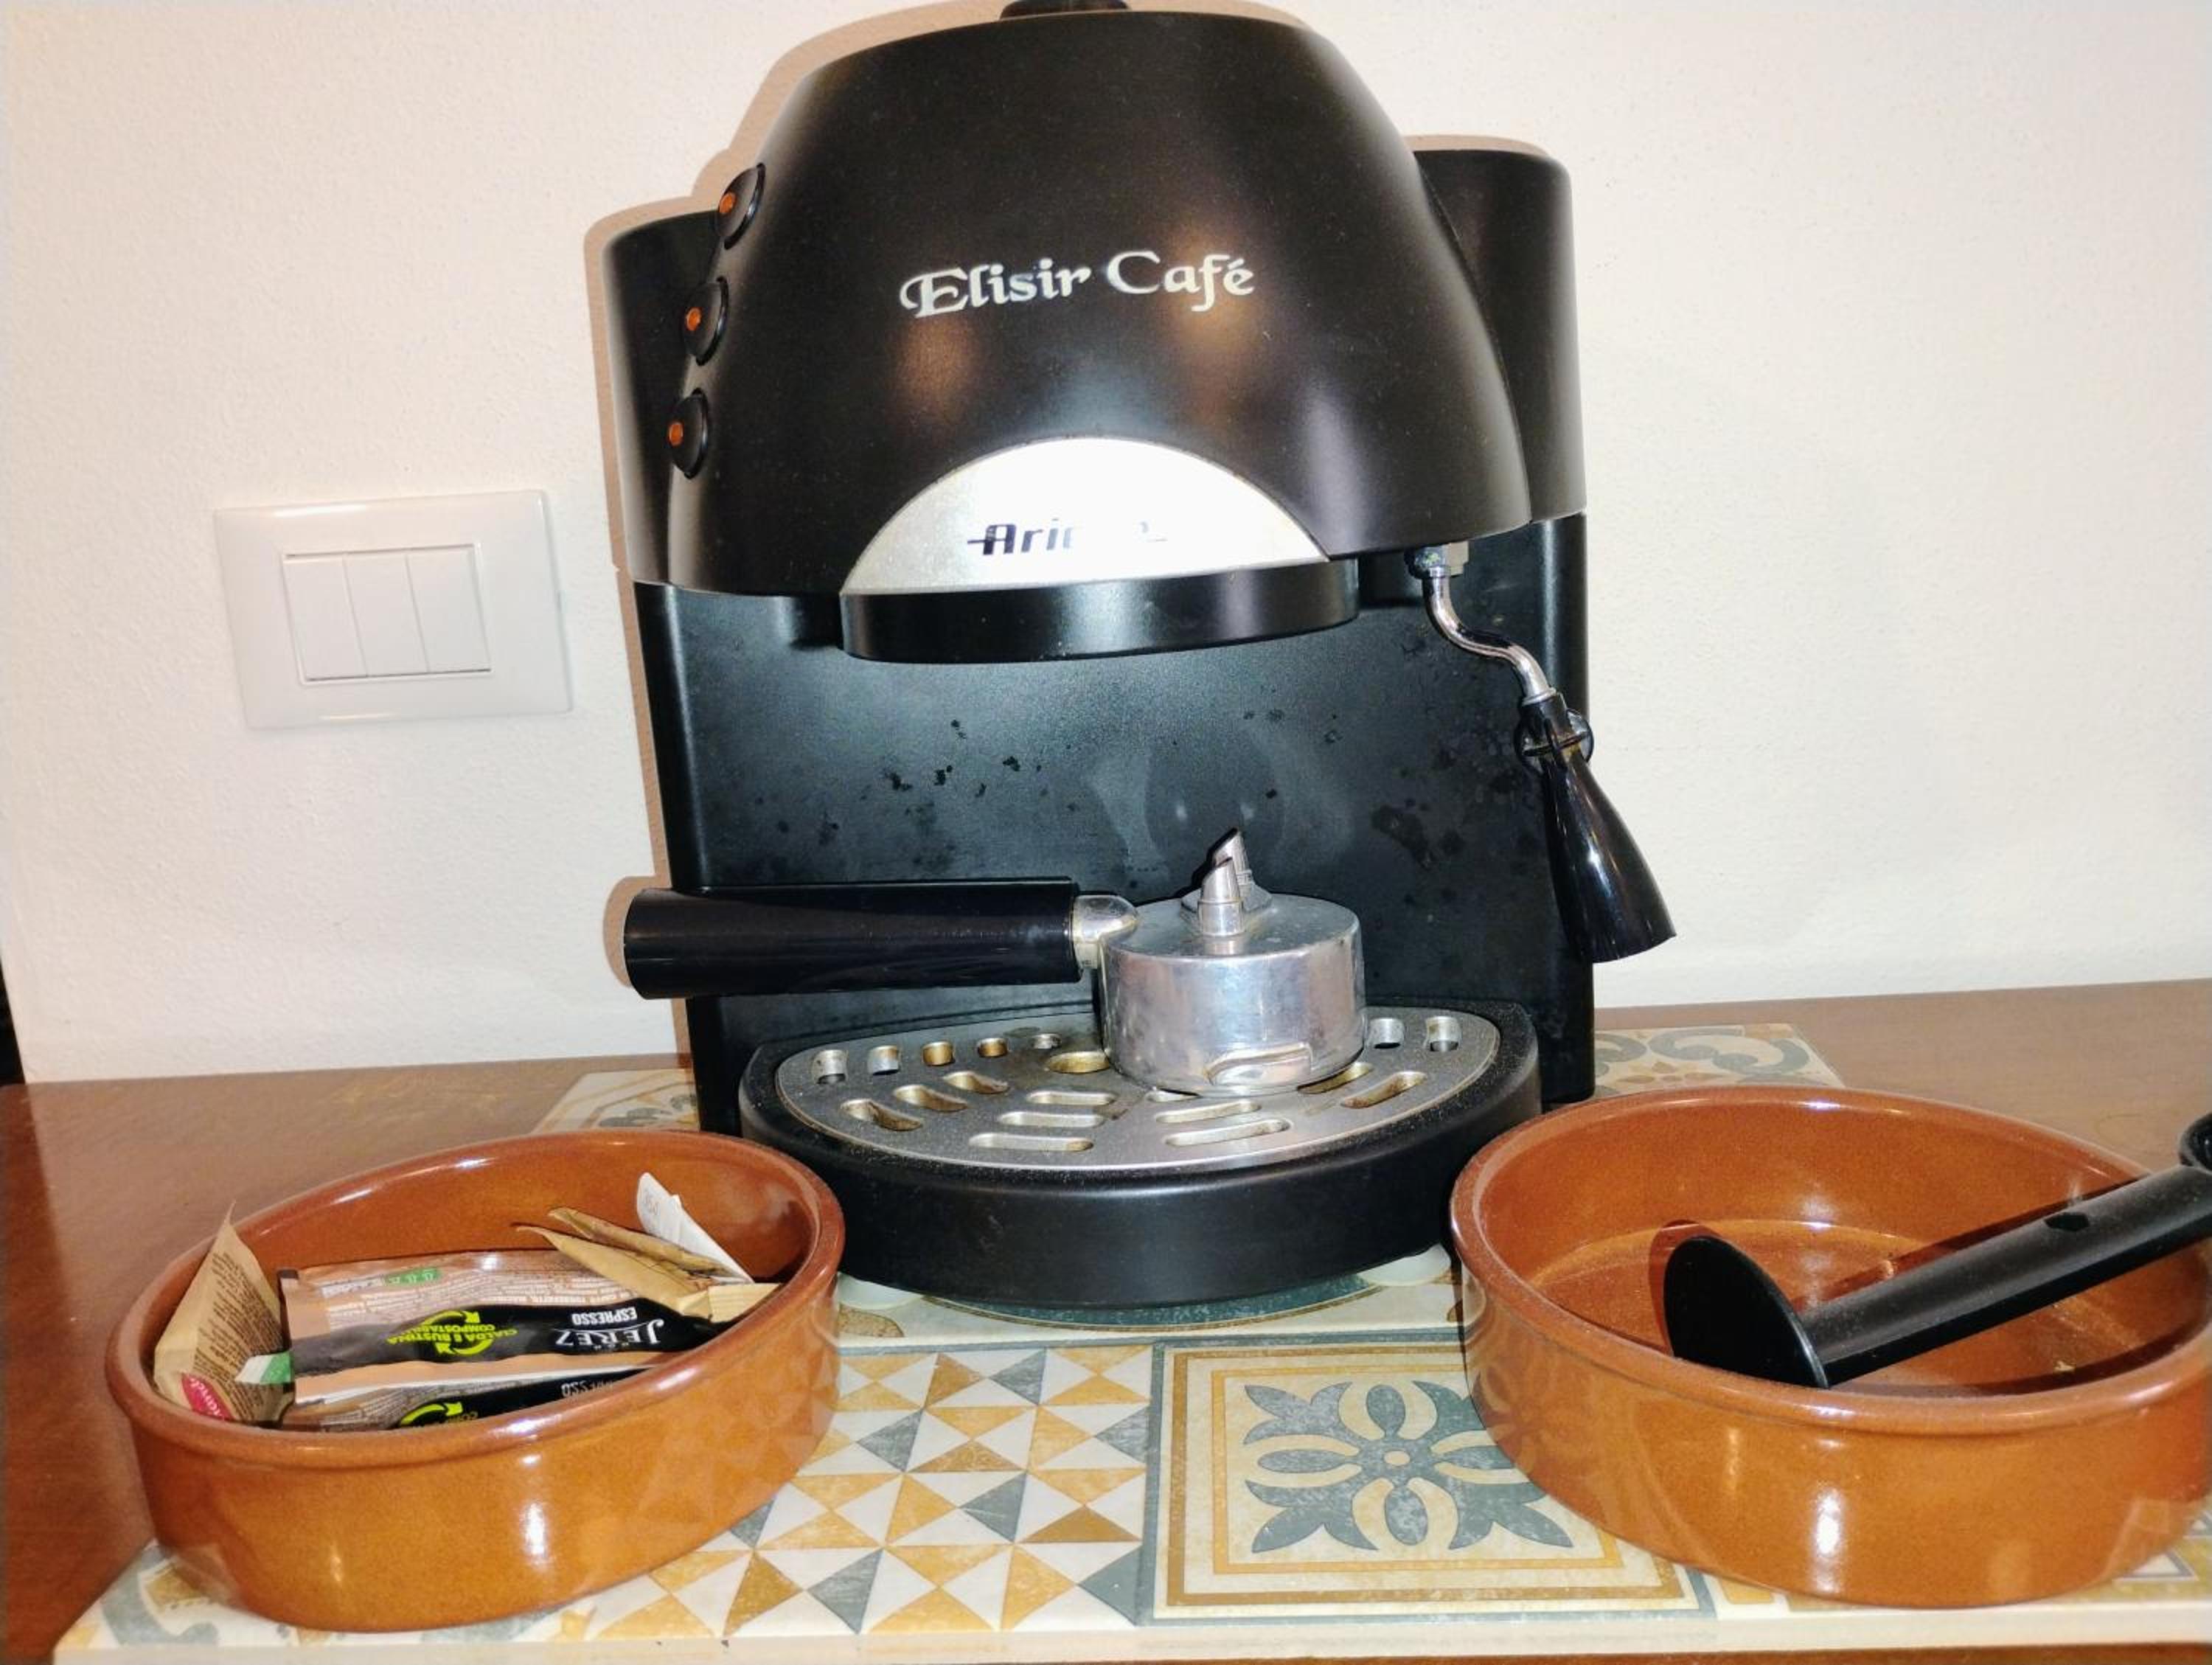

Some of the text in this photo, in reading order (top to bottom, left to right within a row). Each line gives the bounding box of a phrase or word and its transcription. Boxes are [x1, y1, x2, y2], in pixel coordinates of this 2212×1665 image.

[900, 251, 1253, 318] Elisir Café
[571, 1307, 639, 1326] ESPRESSO
[465, 1328, 518, 1341] CIALDA
[555, 1318, 664, 1346] JEREZ
